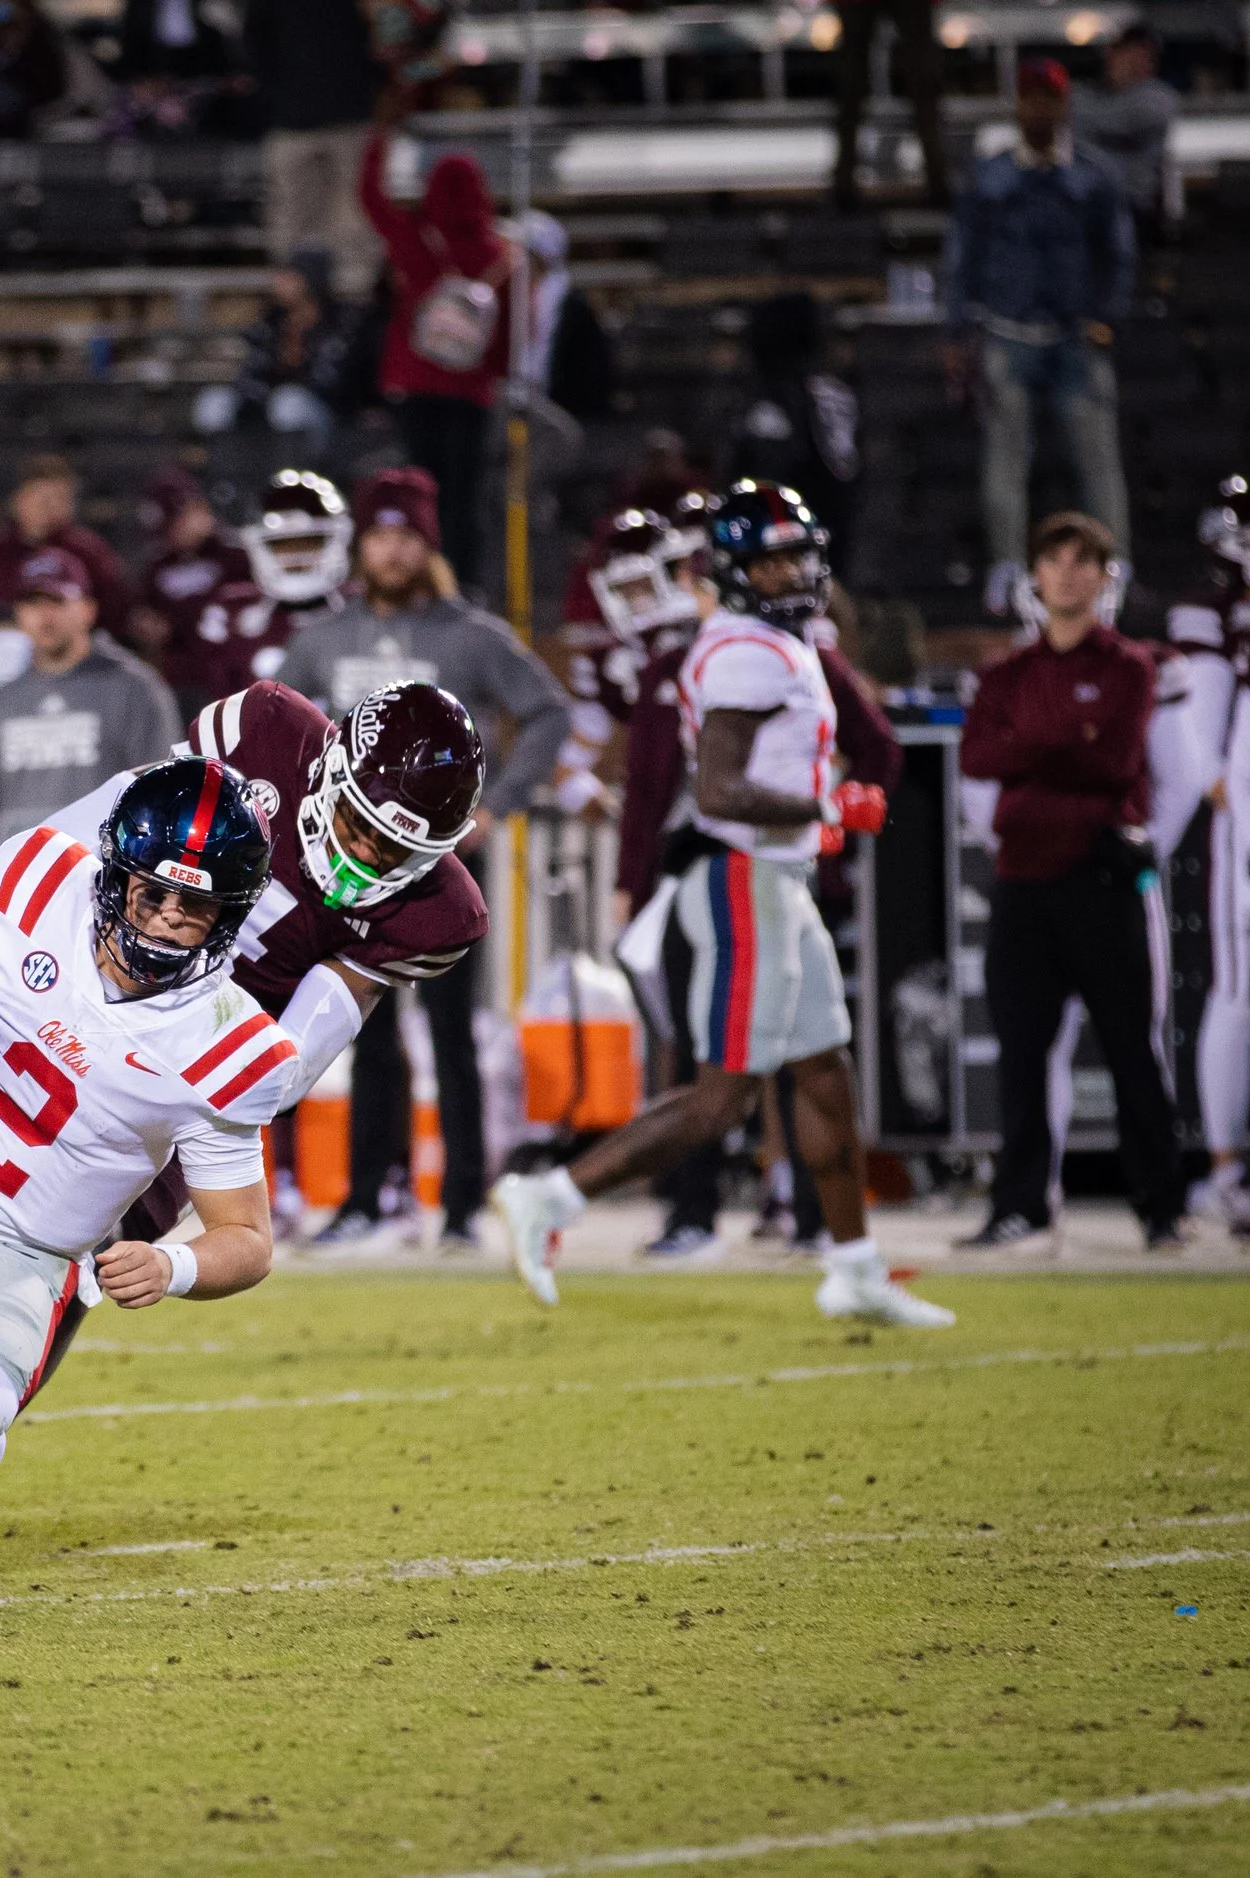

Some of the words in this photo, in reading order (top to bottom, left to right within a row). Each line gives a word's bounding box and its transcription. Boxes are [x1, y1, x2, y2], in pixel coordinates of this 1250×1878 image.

[168, 866, 202, 886] REBS
[23, 953, 57, 991] SEC
[37, 1020, 68, 1048] Ole
[54, 1034, 92, 1078] Miss
